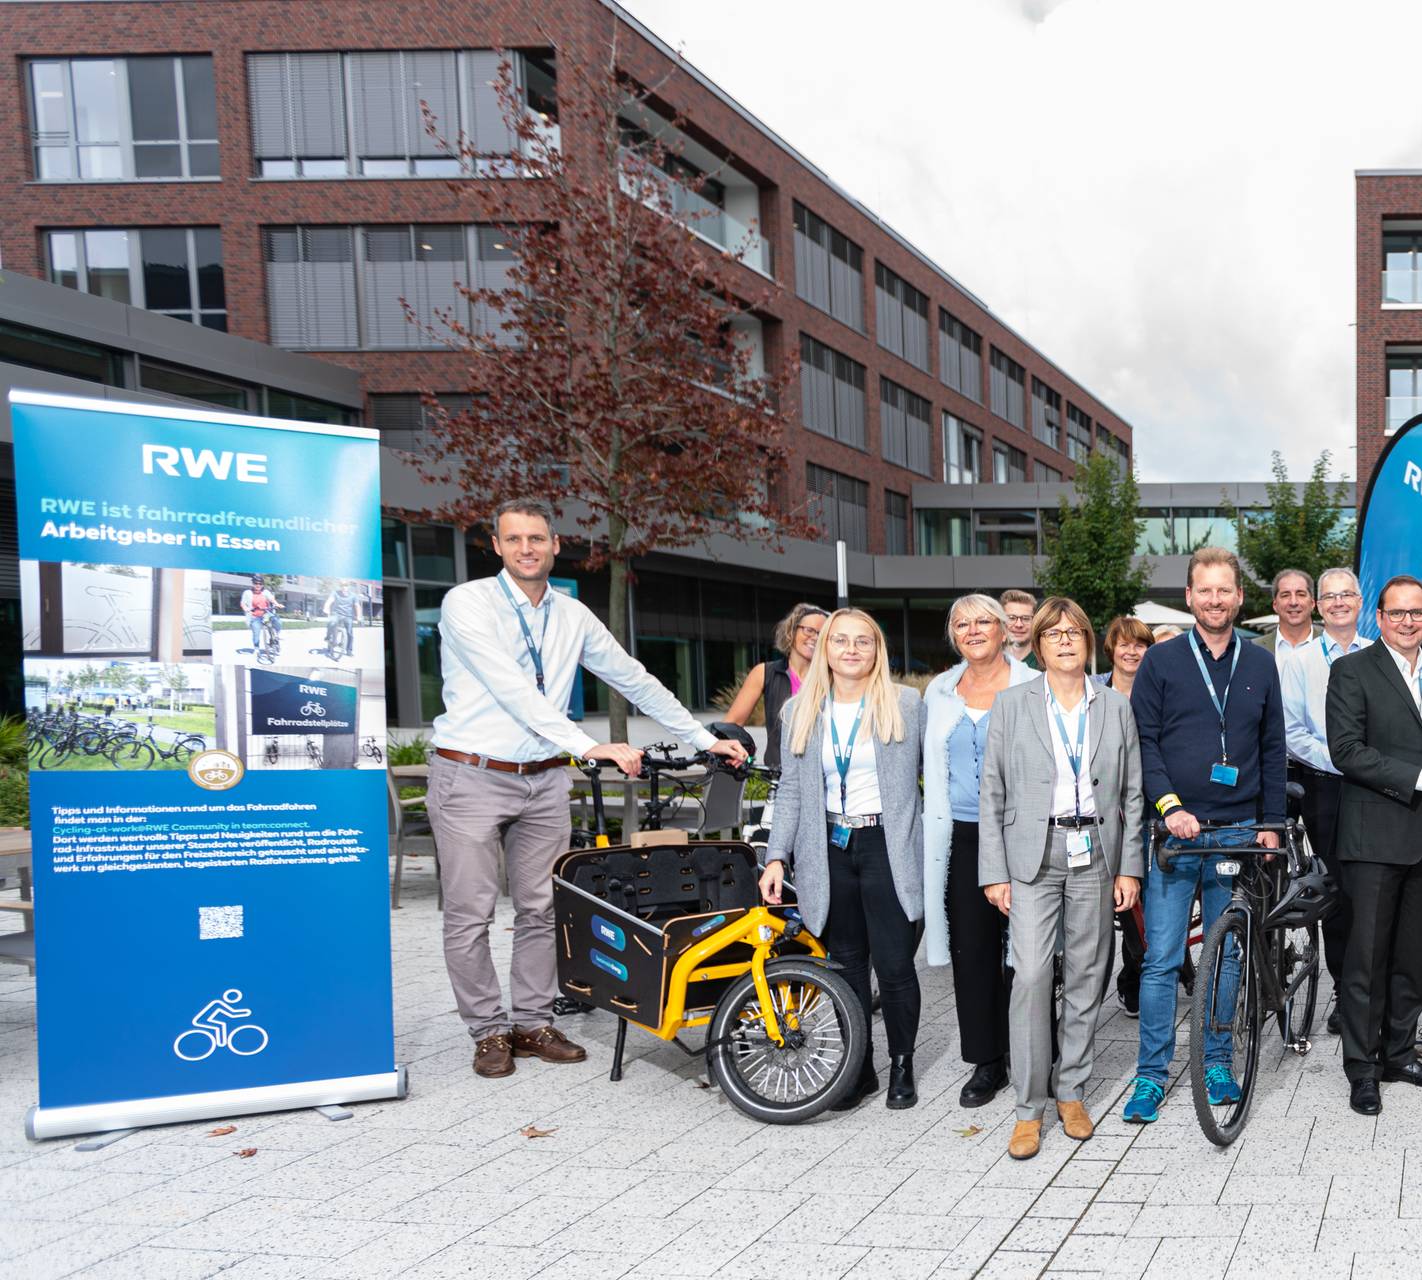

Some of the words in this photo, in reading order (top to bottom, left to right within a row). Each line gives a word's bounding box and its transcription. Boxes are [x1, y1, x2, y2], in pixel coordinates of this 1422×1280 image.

[142, 444, 268, 484] RWE
[40, 498, 96, 516] RWE
[102, 502, 132, 519] ist
[40, 521, 184, 547] Arbeitgeber
[190, 531, 211, 547] in
[217, 534, 281, 552] Essen
[299, 684, 328, 696] RWE
[267, 717, 349, 728] Fahrradstellplätze
[52, 806, 81, 815] Tipps
[83, 806, 104, 814] und
[106, 805, 181, 814] Informationen
[183, 804, 208, 812] rund
[227, 804, 246, 812] das
[247, 803, 317, 811] Fahrradfahren
[54, 815, 85, 824] findet
[87, 816, 112, 824] man
[113, 815, 124, 823] in
[126, 815, 147, 823] der:
[172, 822, 230, 831] Community
[53, 835, 77, 844] Dort
[78, 834, 118, 843] werden
[120, 832, 168, 842] wertvolle
[170, 832, 198, 842] Tipps
[199, 832, 220, 840] und
[221, 830, 280, 840] Neuigkeiten
[281, 829, 304, 838] rund
[321, 829, 337, 837] die
[187, 840, 239, 850] Standorte
[307, 837, 358, 846] Radrouten
[53, 855, 74, 863] und
[76, 852, 143, 863] Erfahrungen
[144, 851, 161, 860] für
[162, 851, 182, 859] den
[184, 848, 257, 858] Freizeitbereich
[258, 847, 307, 857] getauscht
[308, 846, 327, 854] und
[53, 864, 79, 873] werk
[185, 859, 248, 869] begeisterten
